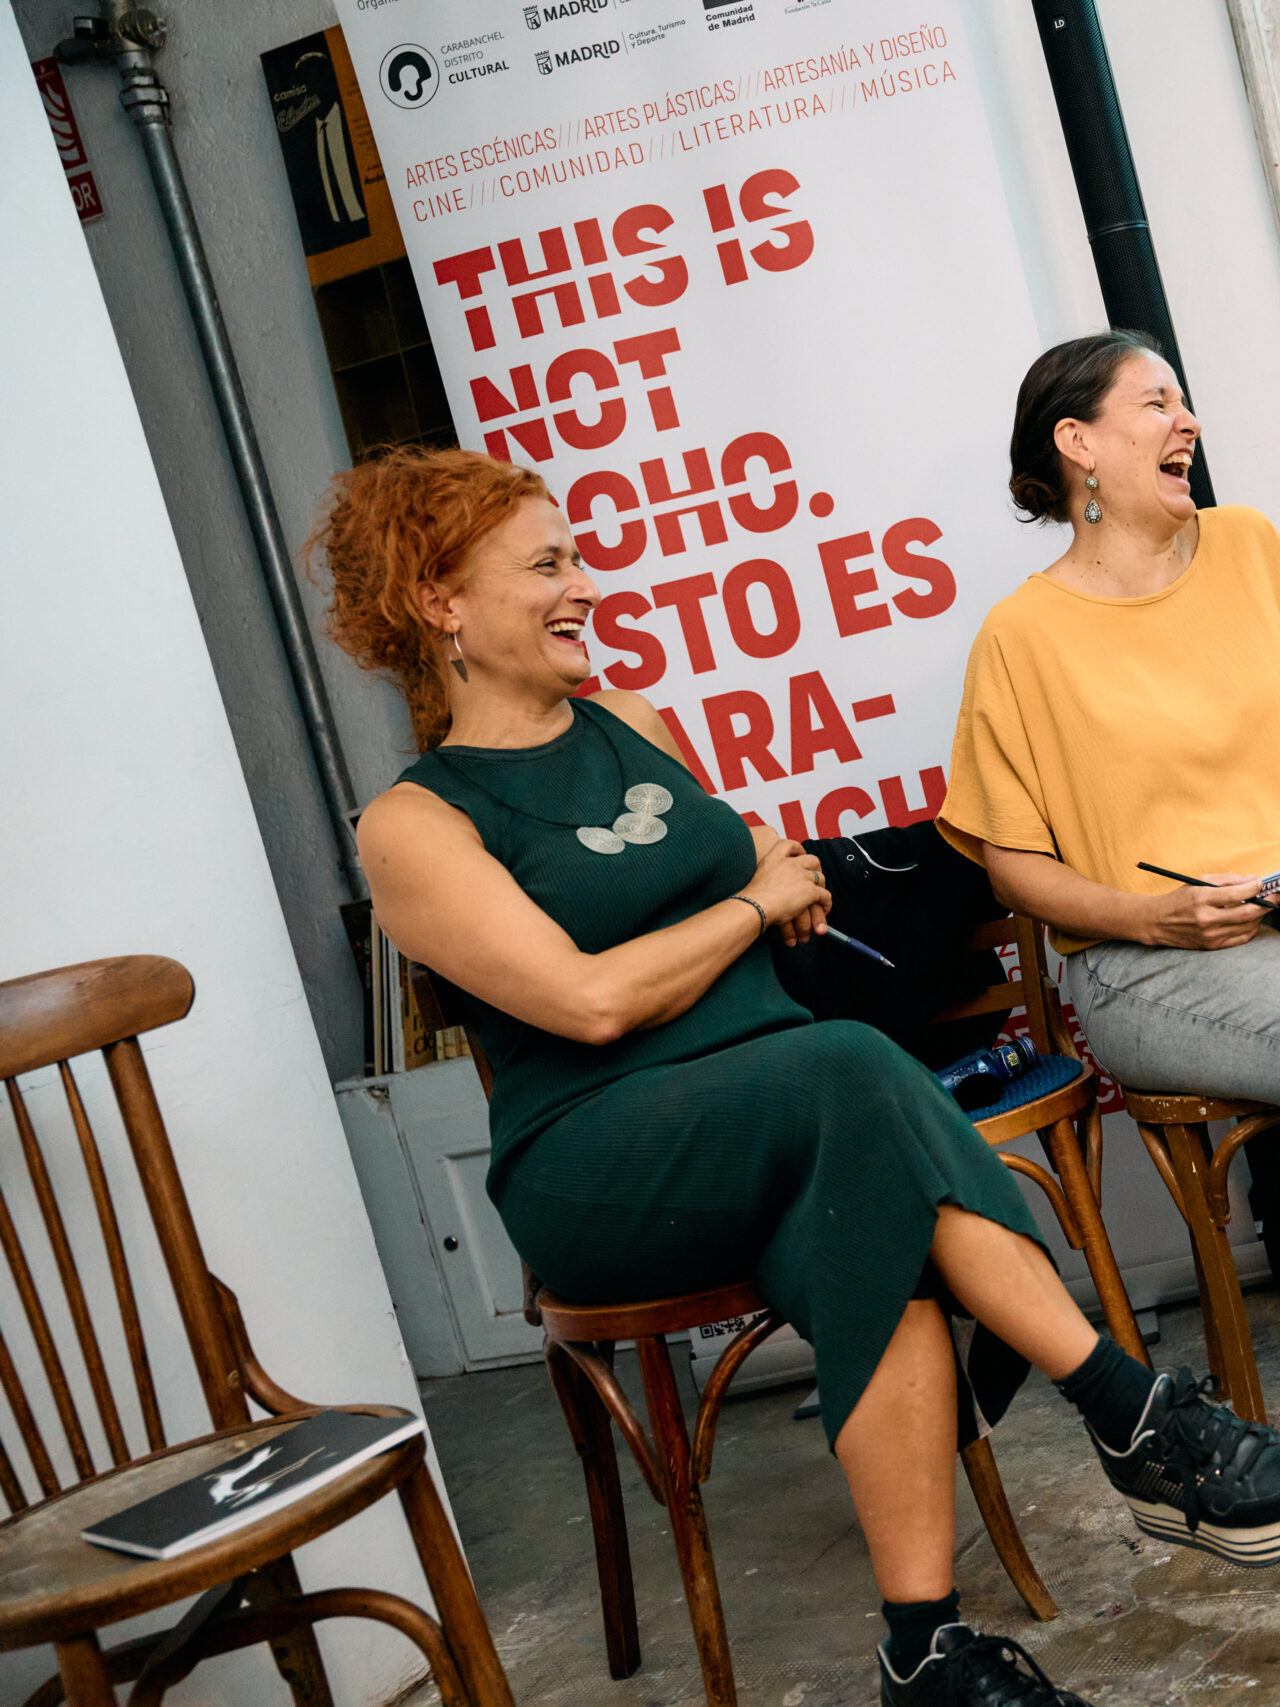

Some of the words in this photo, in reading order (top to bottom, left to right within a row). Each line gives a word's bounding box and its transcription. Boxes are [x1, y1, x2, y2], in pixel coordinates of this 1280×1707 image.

[705, 4, 753, 21] Comunidad
[708, 23, 720, 31] de
[722, 13, 756, 28] Madrid
[657, 19, 686, 32] Turismo
[440, 31, 505, 54] CARABANCHEL
[637, 33, 666, 46] Deporte
[444, 51, 484, 68] DISTRITO
[555, 40, 620, 67] MADRID
[448, 60, 510, 85] CULTURAL
[406, 154, 459, 190] ARTES
[862, 42, 875, 65] Y
[880, 24, 947, 62] DISEÑO
[433, 203, 690, 352] THIS
[702, 169, 815, 287] IS
[469, 327, 681, 463] NOT
[550, 432, 834, 572] OHO.
[583, 559, 801, 692] STO
[817, 517, 957, 639] ES
